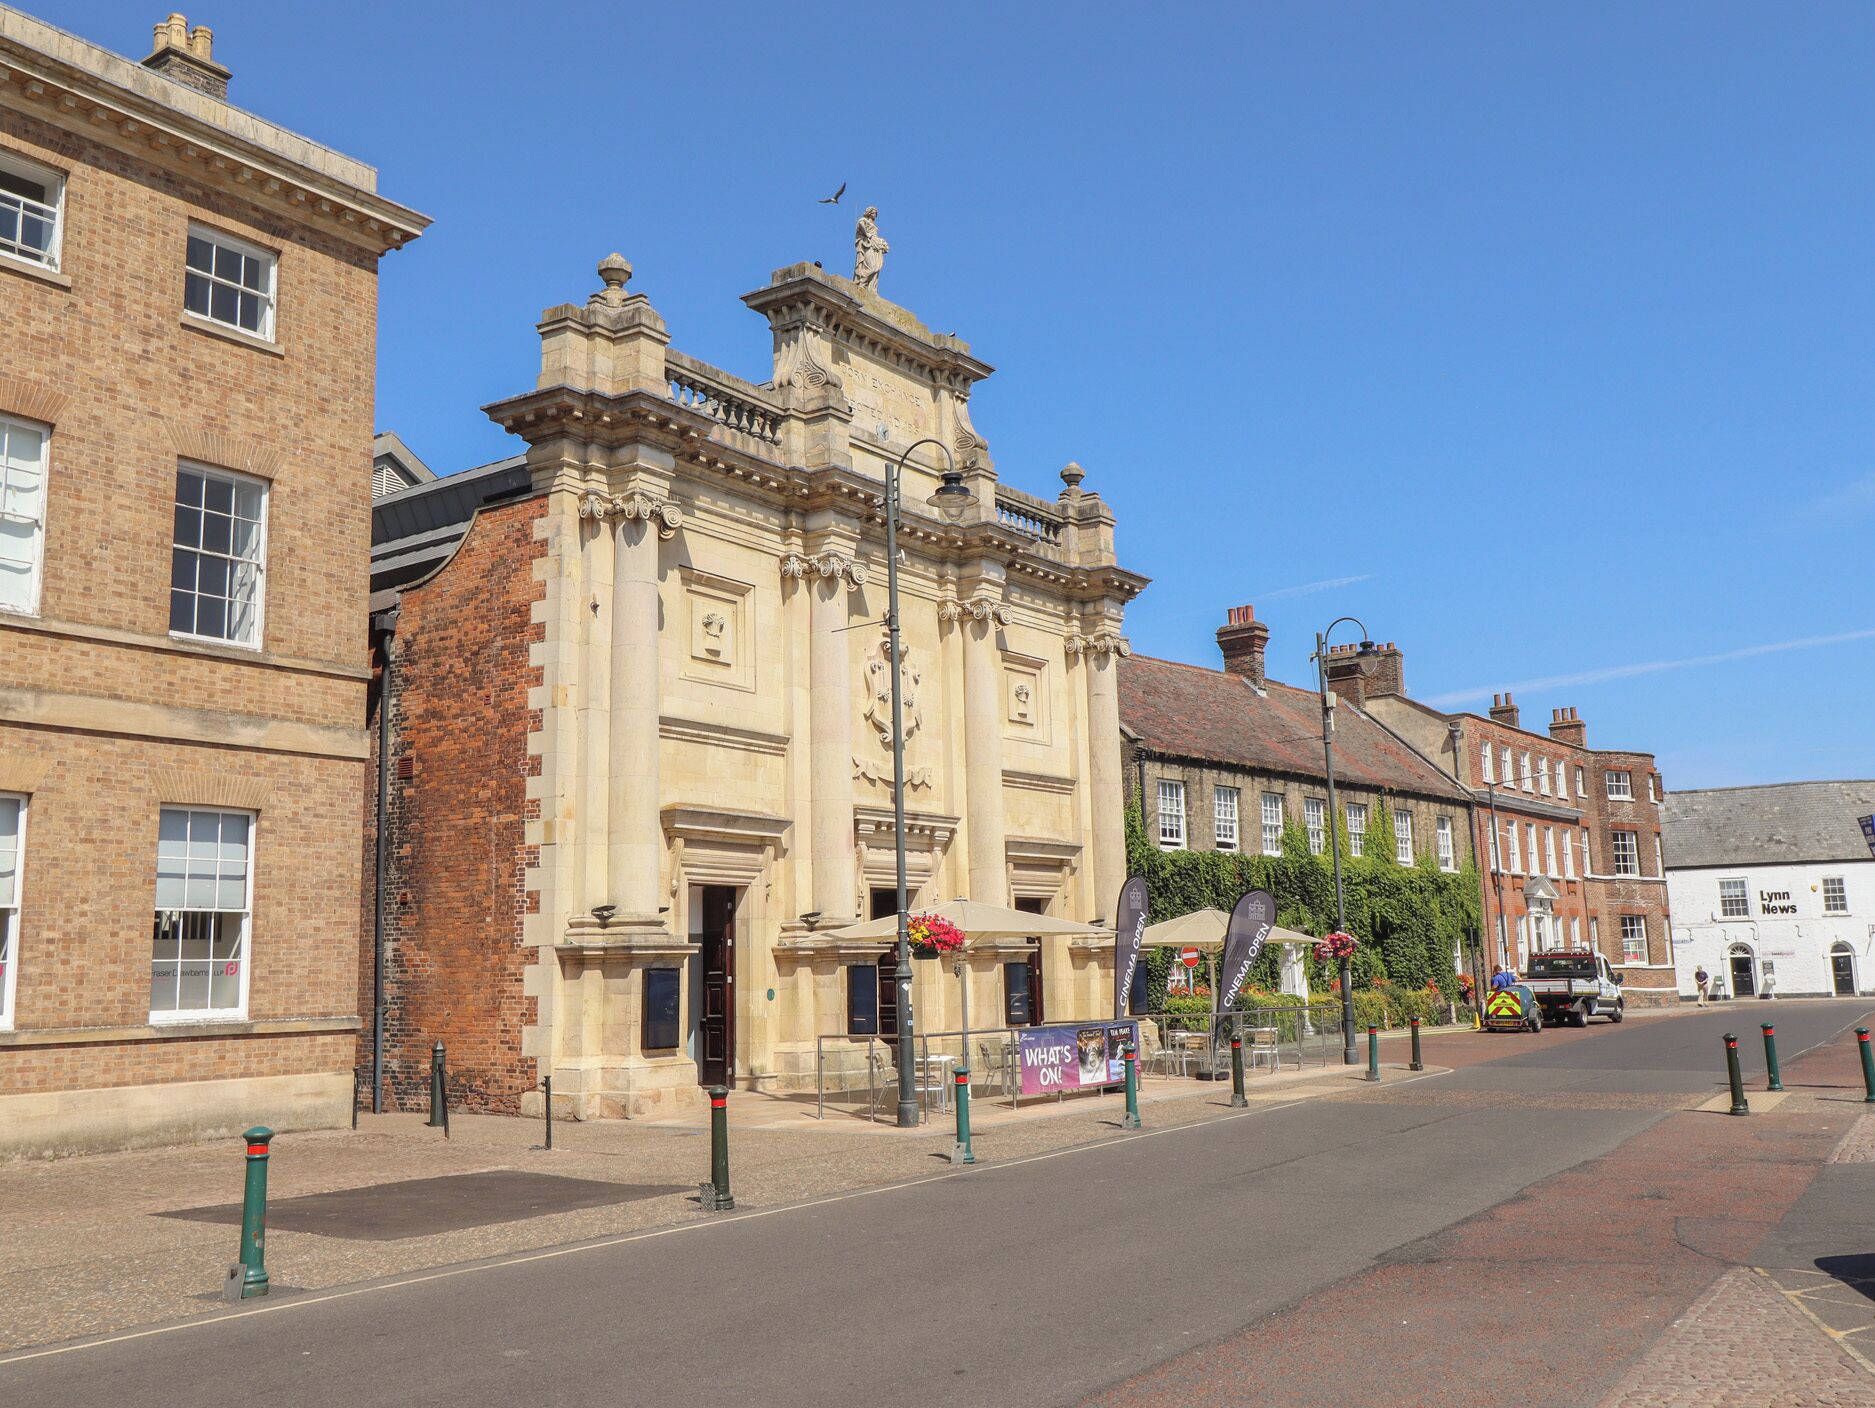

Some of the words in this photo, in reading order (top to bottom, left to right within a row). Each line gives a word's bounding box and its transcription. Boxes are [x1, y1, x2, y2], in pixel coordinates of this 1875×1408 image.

[1760, 889, 1790, 903] Lynn
[1762, 902, 1797, 915] News
[1120, 952, 1137, 1007] CINEMA
[1133, 911, 1147, 950] OPEN
[1223, 961, 1252, 1008] CINEMA
[1248, 922, 1270, 958] OPEN
[1025, 1045, 1072, 1067] WHAT'S
[1040, 1066, 1063, 1086] ON!
